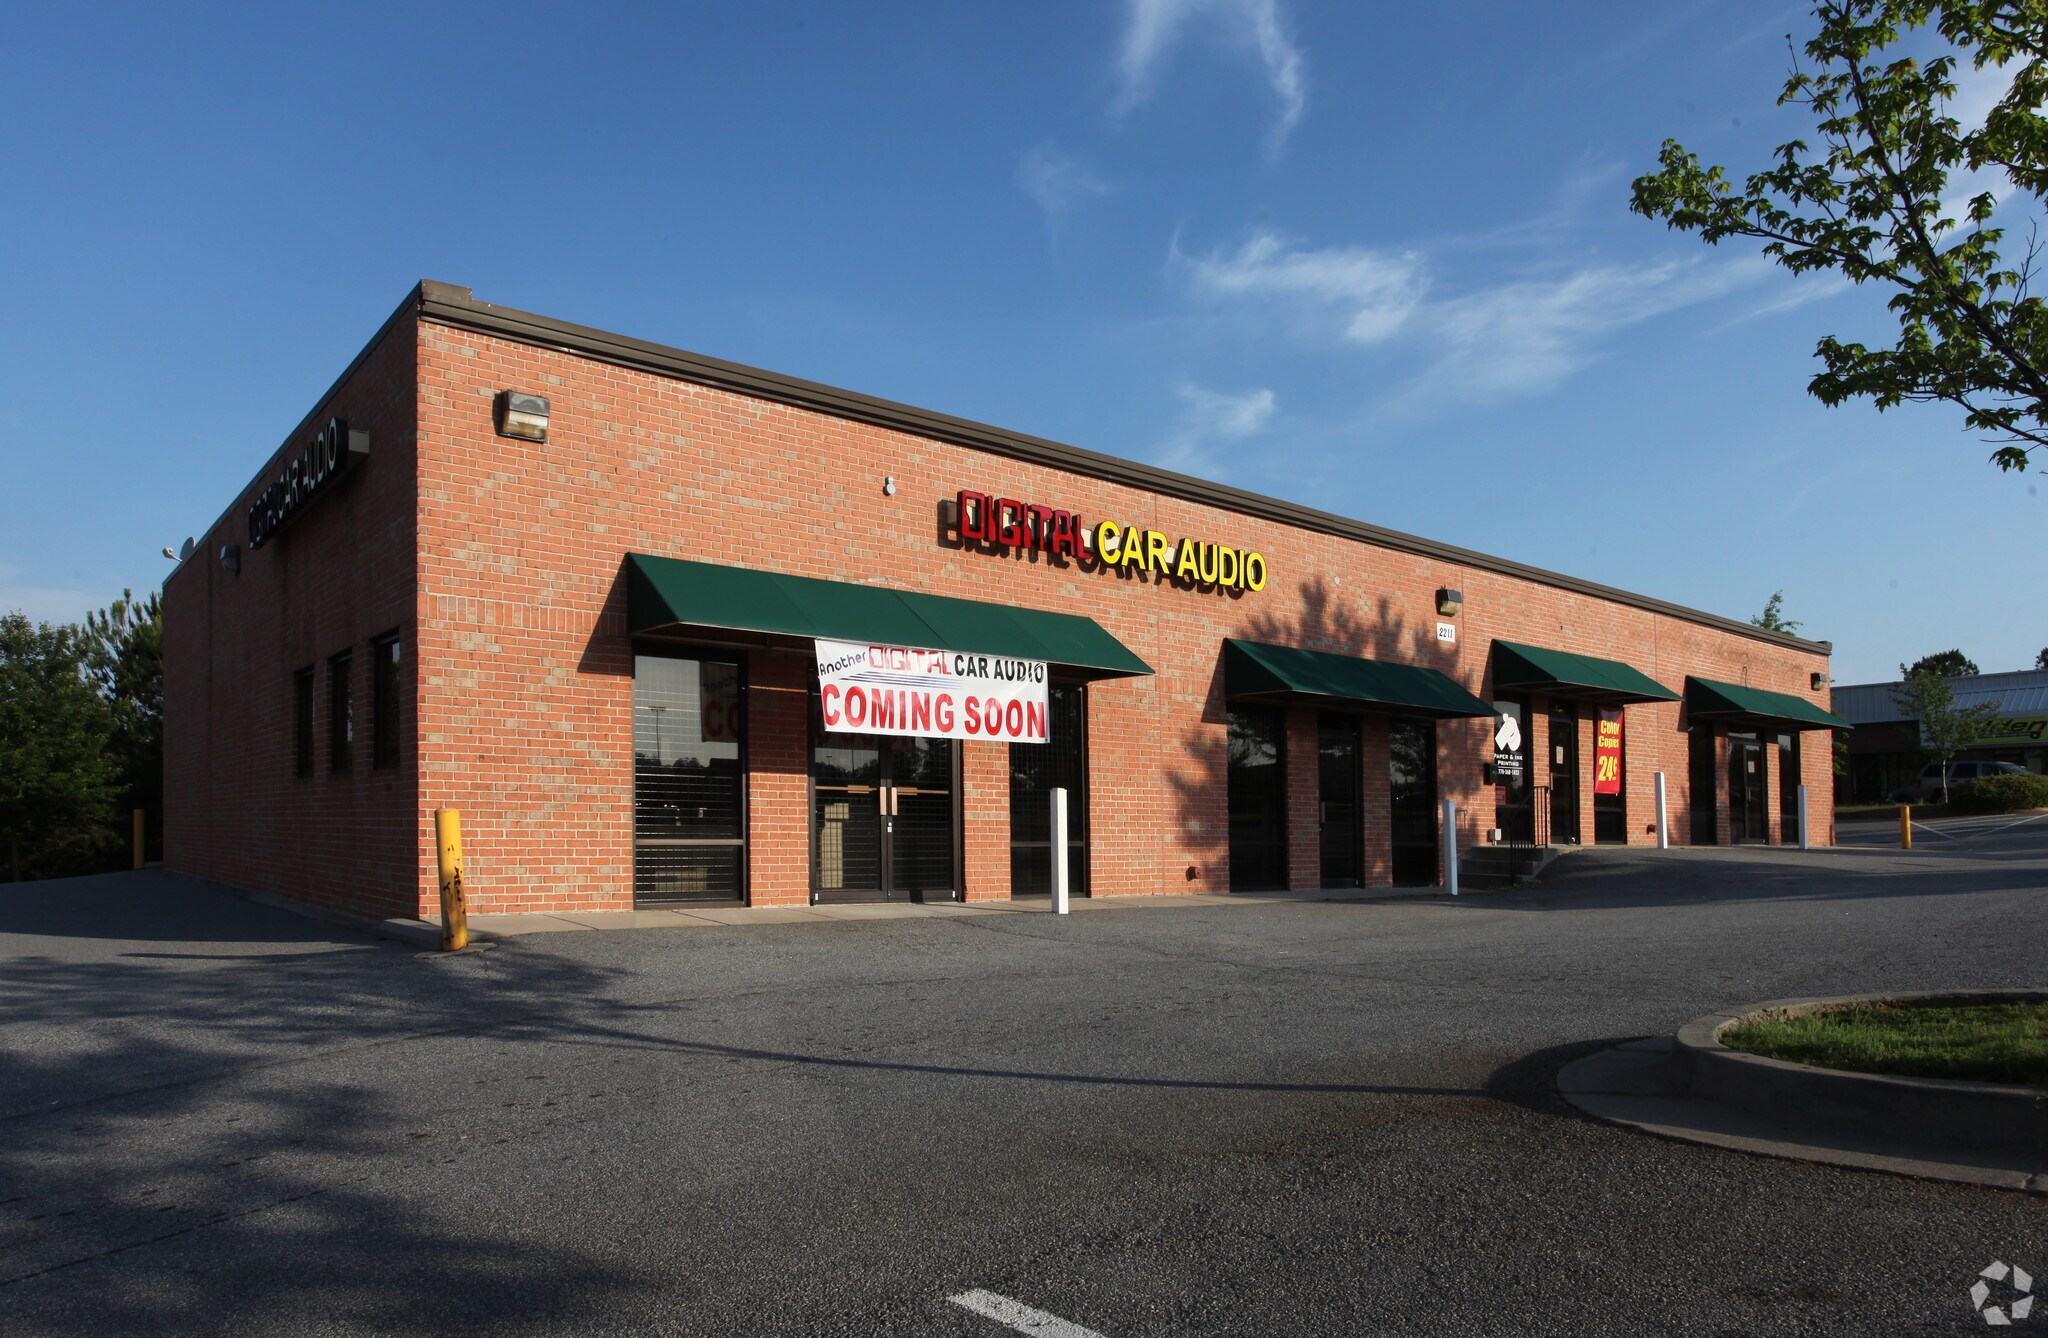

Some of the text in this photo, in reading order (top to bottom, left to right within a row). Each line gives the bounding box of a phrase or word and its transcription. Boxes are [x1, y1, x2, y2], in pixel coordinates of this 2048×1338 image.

[278, 417, 337, 520] CAR AUDIO
[958, 490, 1268, 592] DIGITAL CAR AUDIO
[819, 645, 1045, 684] Another DIGITAL CAR AUDIO
[821, 683, 1046, 738] COMING SOON
[1600, 720, 1620, 735] Color
[1598, 735, 1620, 748] Copies
